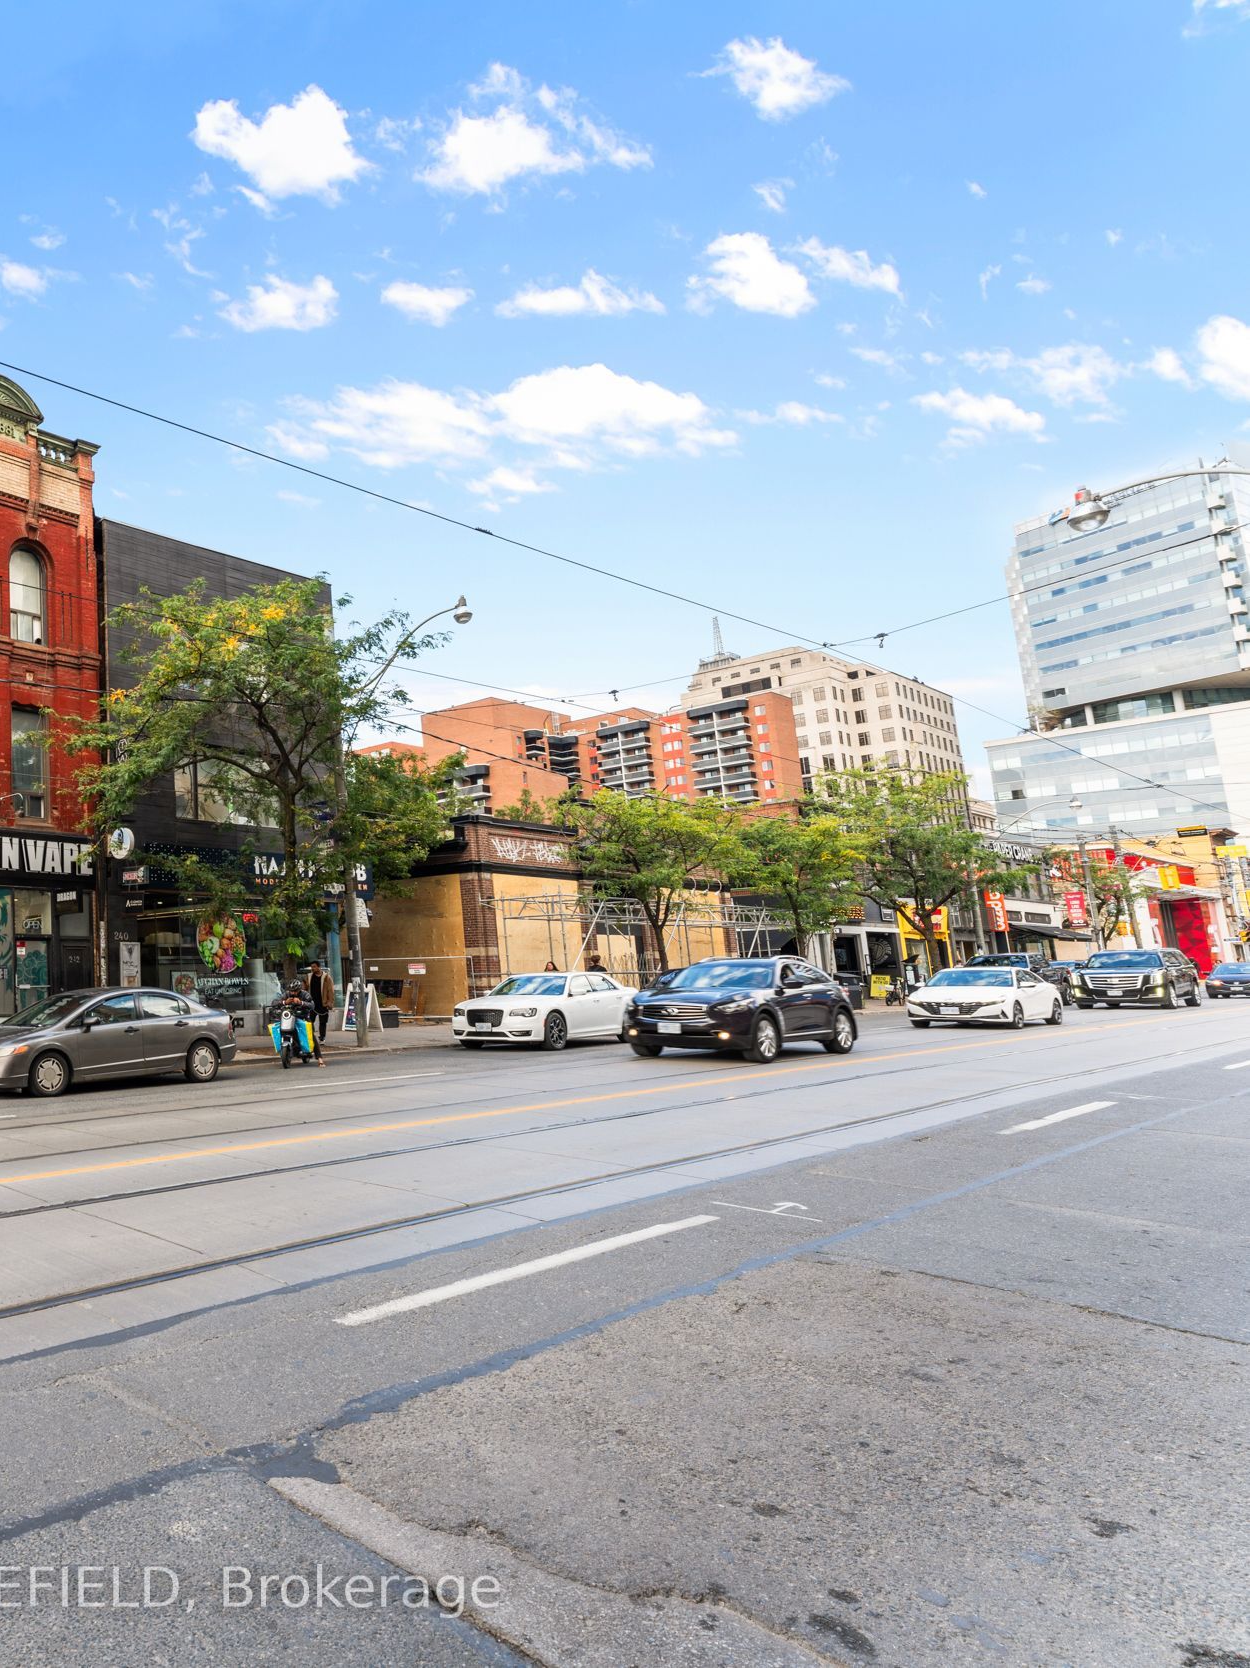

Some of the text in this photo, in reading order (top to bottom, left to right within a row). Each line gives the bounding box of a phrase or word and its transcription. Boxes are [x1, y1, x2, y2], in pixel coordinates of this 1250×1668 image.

[21, 839, 94, 876] VAPE
[56, 891, 77, 902] DRAGON
[23, 920, 44, 930] OPEN
[113, 930, 129, 941] 240
[224, 977, 249, 986] BOWLS
